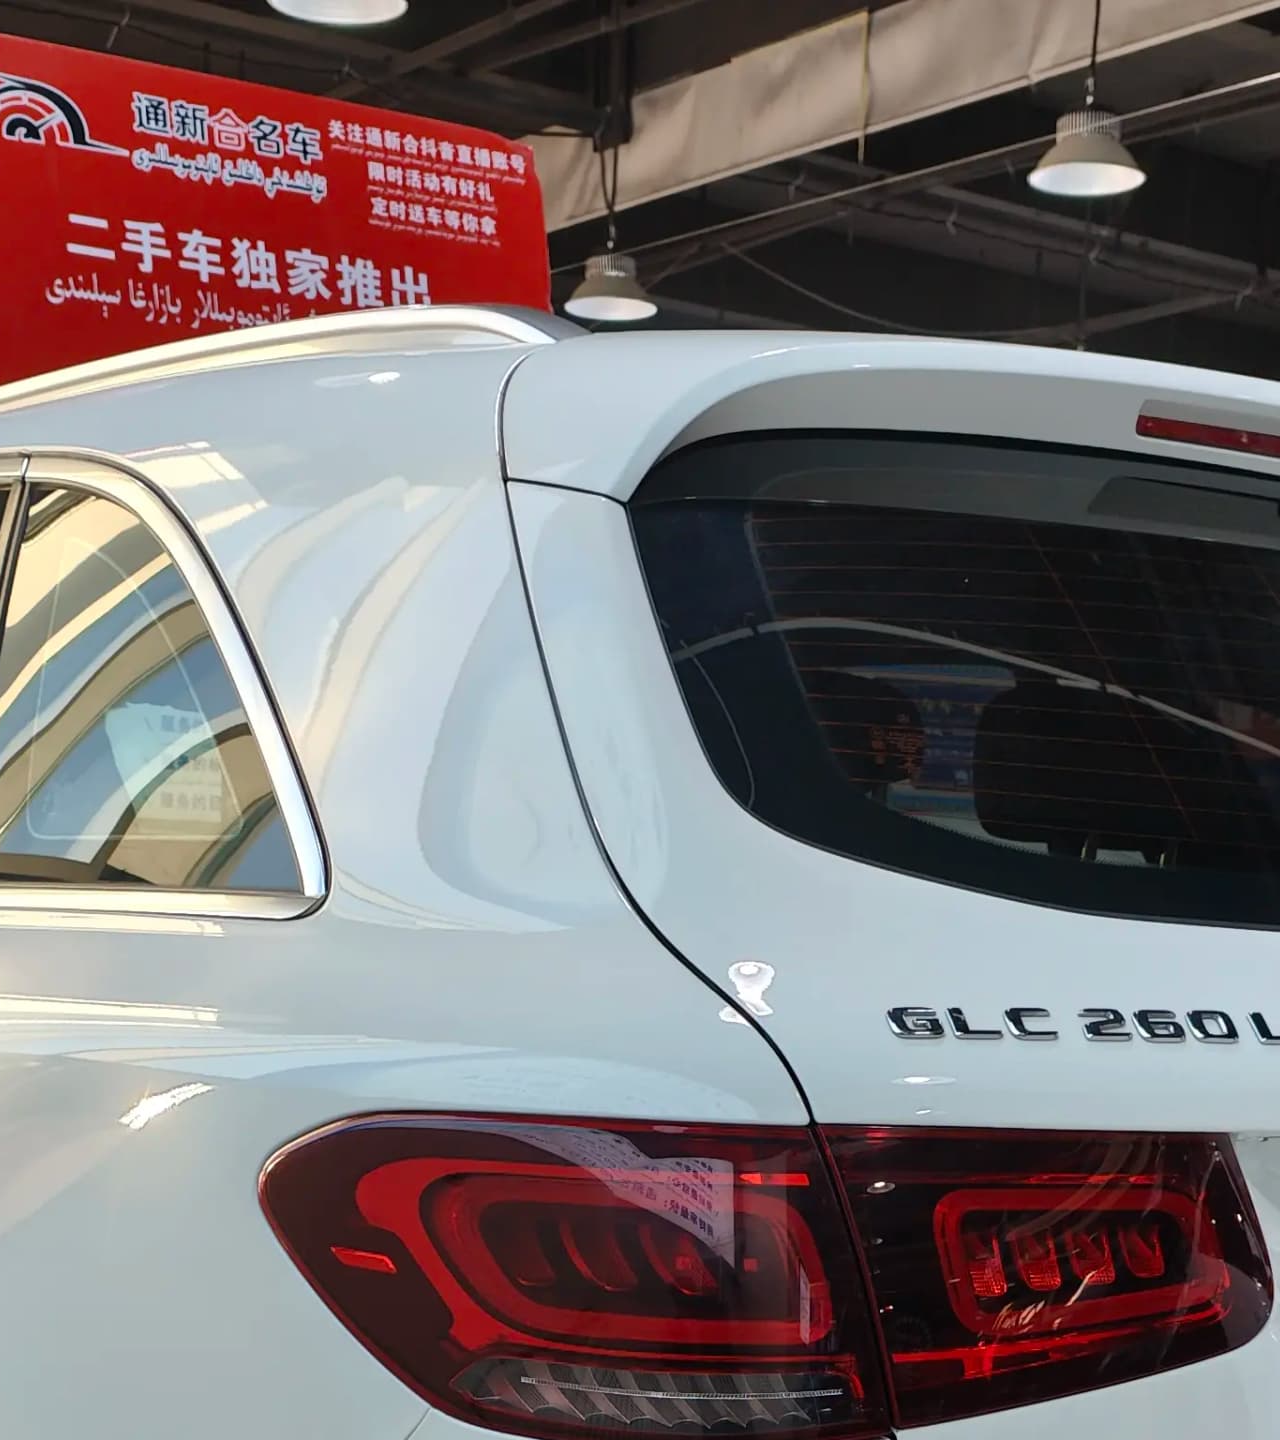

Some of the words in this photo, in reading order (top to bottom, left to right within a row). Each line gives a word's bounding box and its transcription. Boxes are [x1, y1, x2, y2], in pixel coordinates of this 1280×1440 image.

[132, 92, 323, 164] 通新合名车
[328, 119, 526, 174] 关注通新合抖音直播账号
[367, 161, 495, 202] 限时活动有好礼
[371, 197, 497, 236] 定时送车等你拿
[65, 212, 432, 308] 二手车独家推出
[886, 1005, 1059, 1041] GLC
[1079, 1007, 1241, 1044] 260
